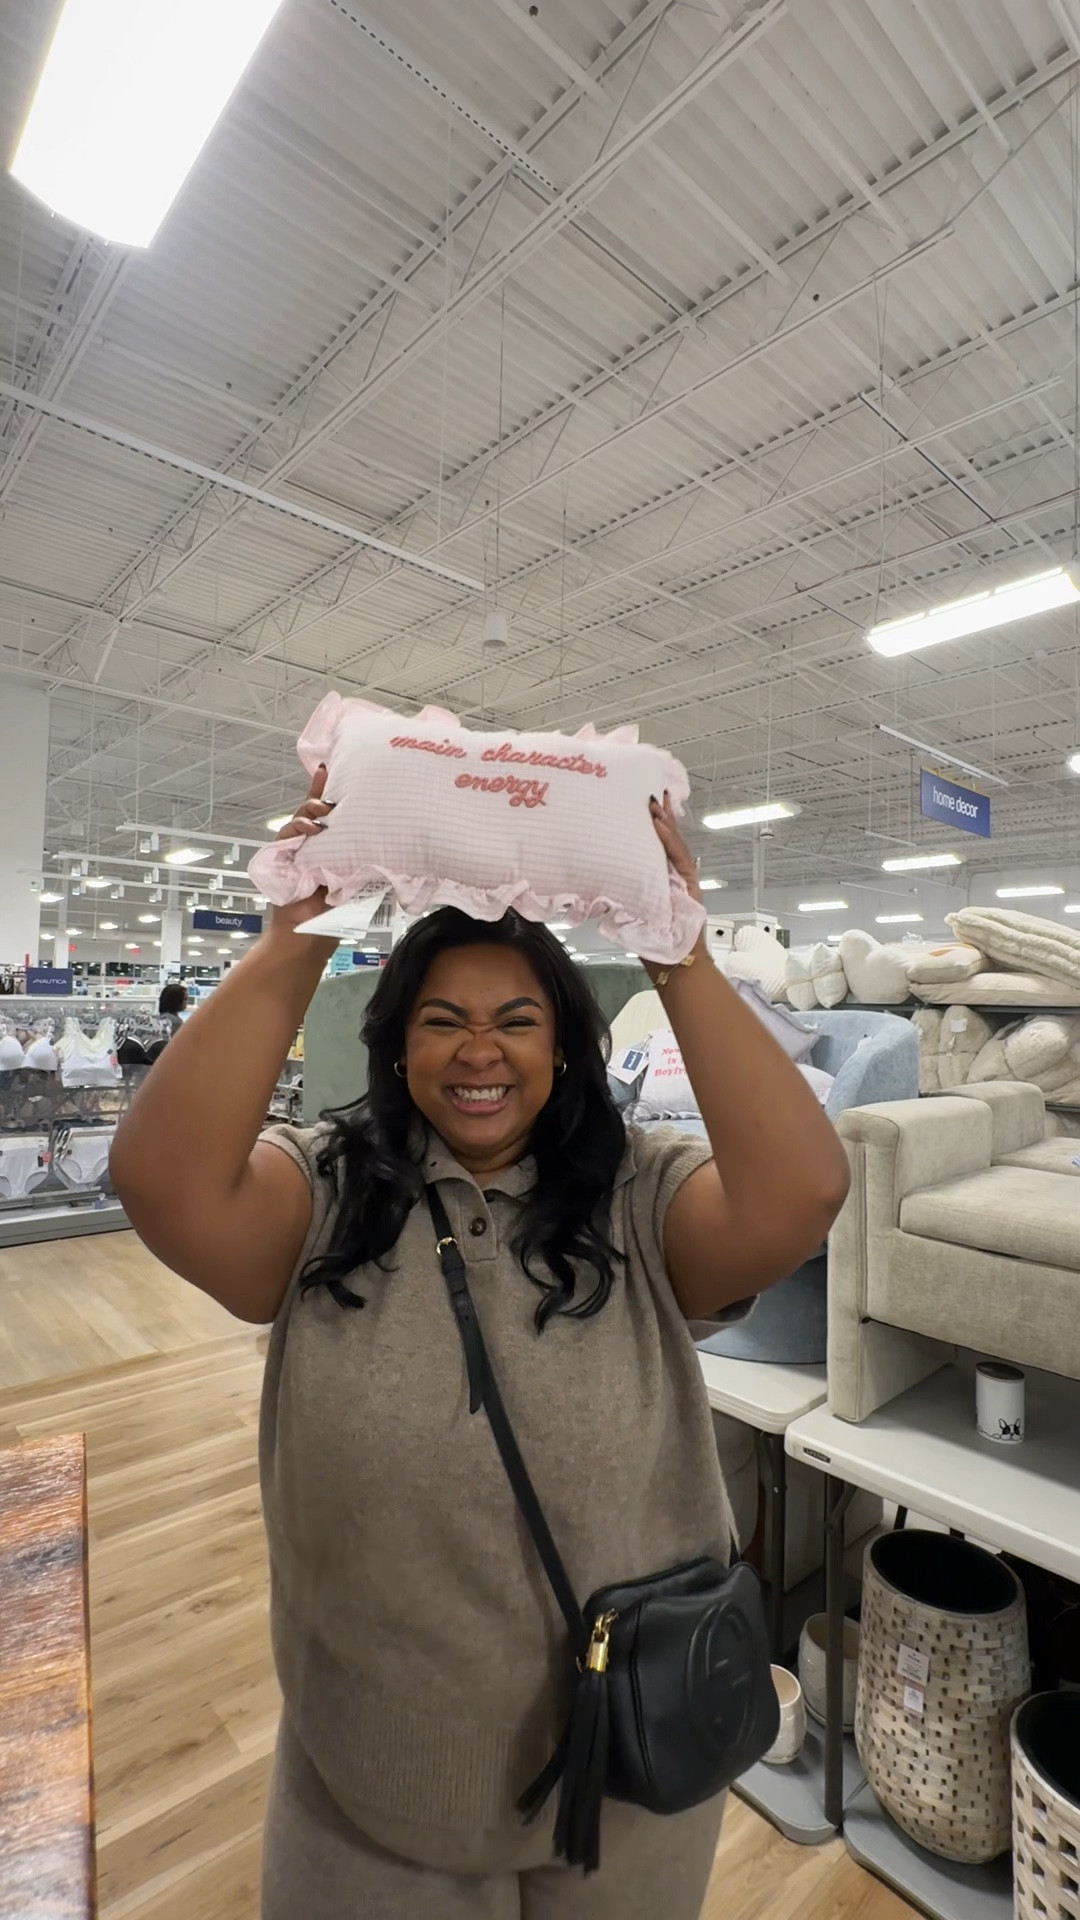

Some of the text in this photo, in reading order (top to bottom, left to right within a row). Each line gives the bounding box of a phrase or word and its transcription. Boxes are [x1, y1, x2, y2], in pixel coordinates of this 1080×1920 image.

[390, 736, 607, 778] main character
[455, 773, 548, 808] energy
[933, 785, 978, 818] home decor
[215, 915, 243, 928] beauty
